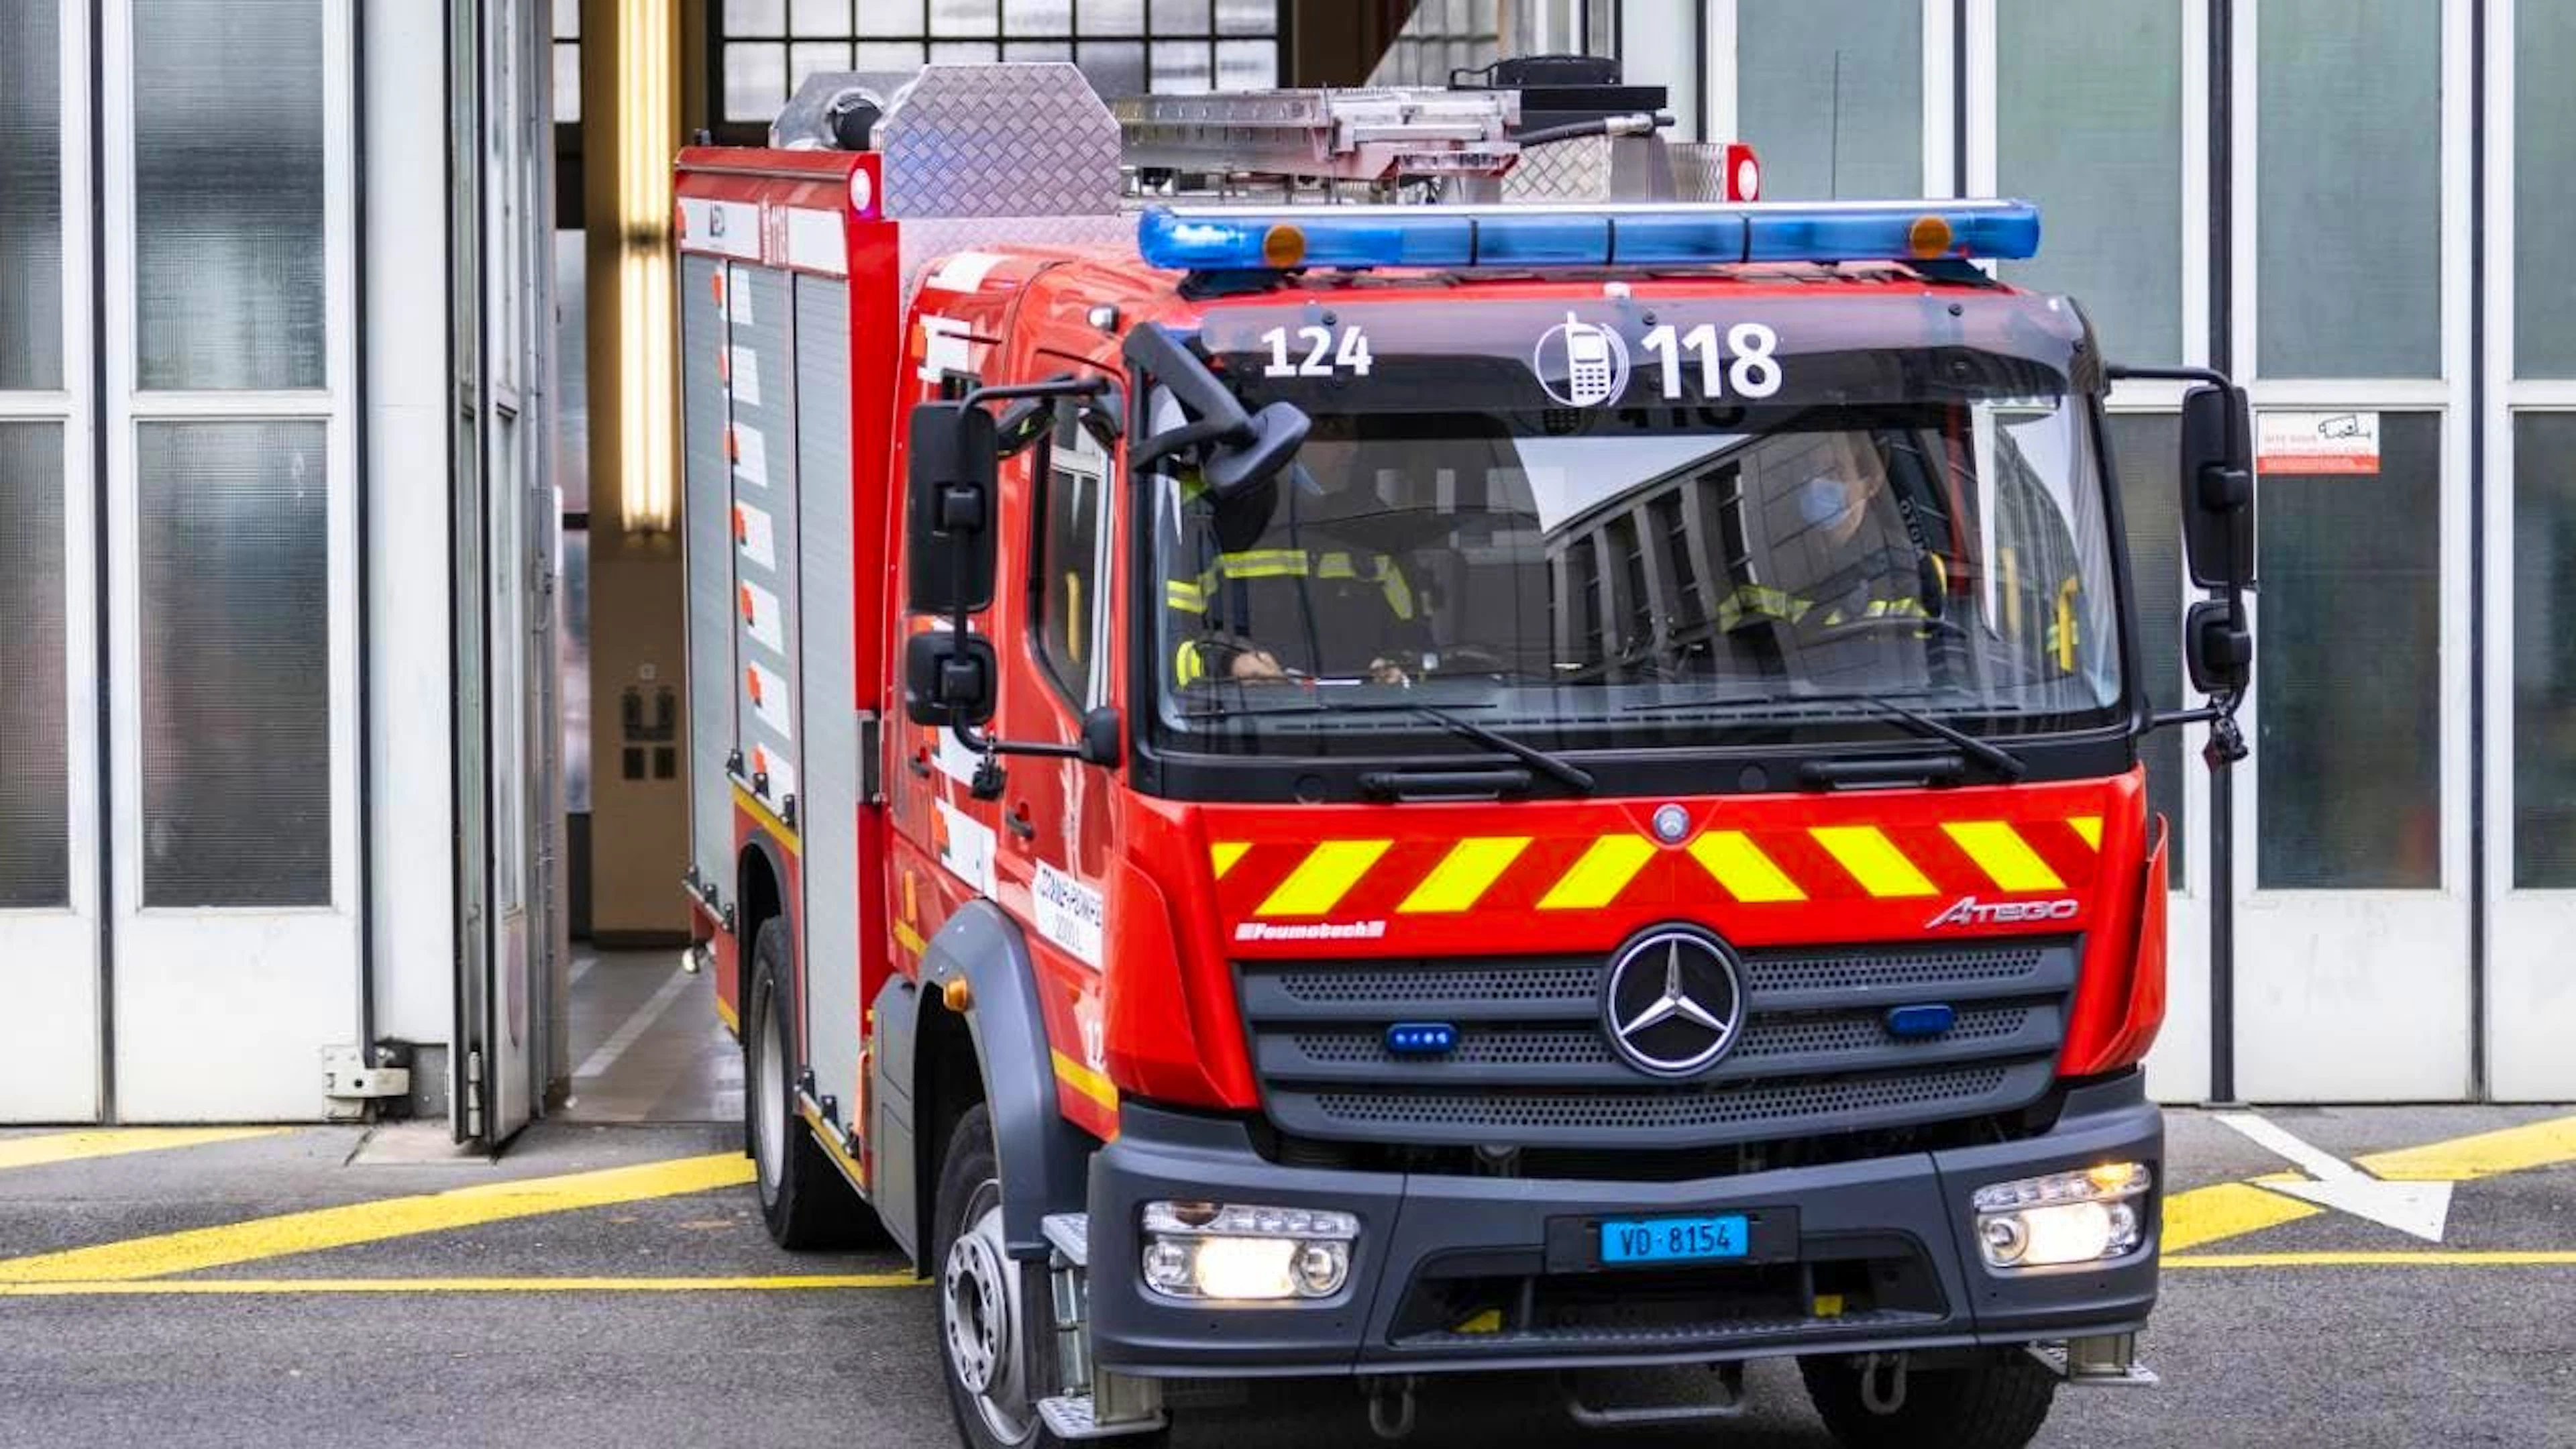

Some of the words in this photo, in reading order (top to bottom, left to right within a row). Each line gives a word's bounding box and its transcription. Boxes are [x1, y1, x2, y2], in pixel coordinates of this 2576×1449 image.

[1261, 326, 1373, 377] 124
[1641, 323, 1783, 398] 118
[1621, 1228, 1650, 1256] VD
[1669, 1224, 1730, 1253] 8154
